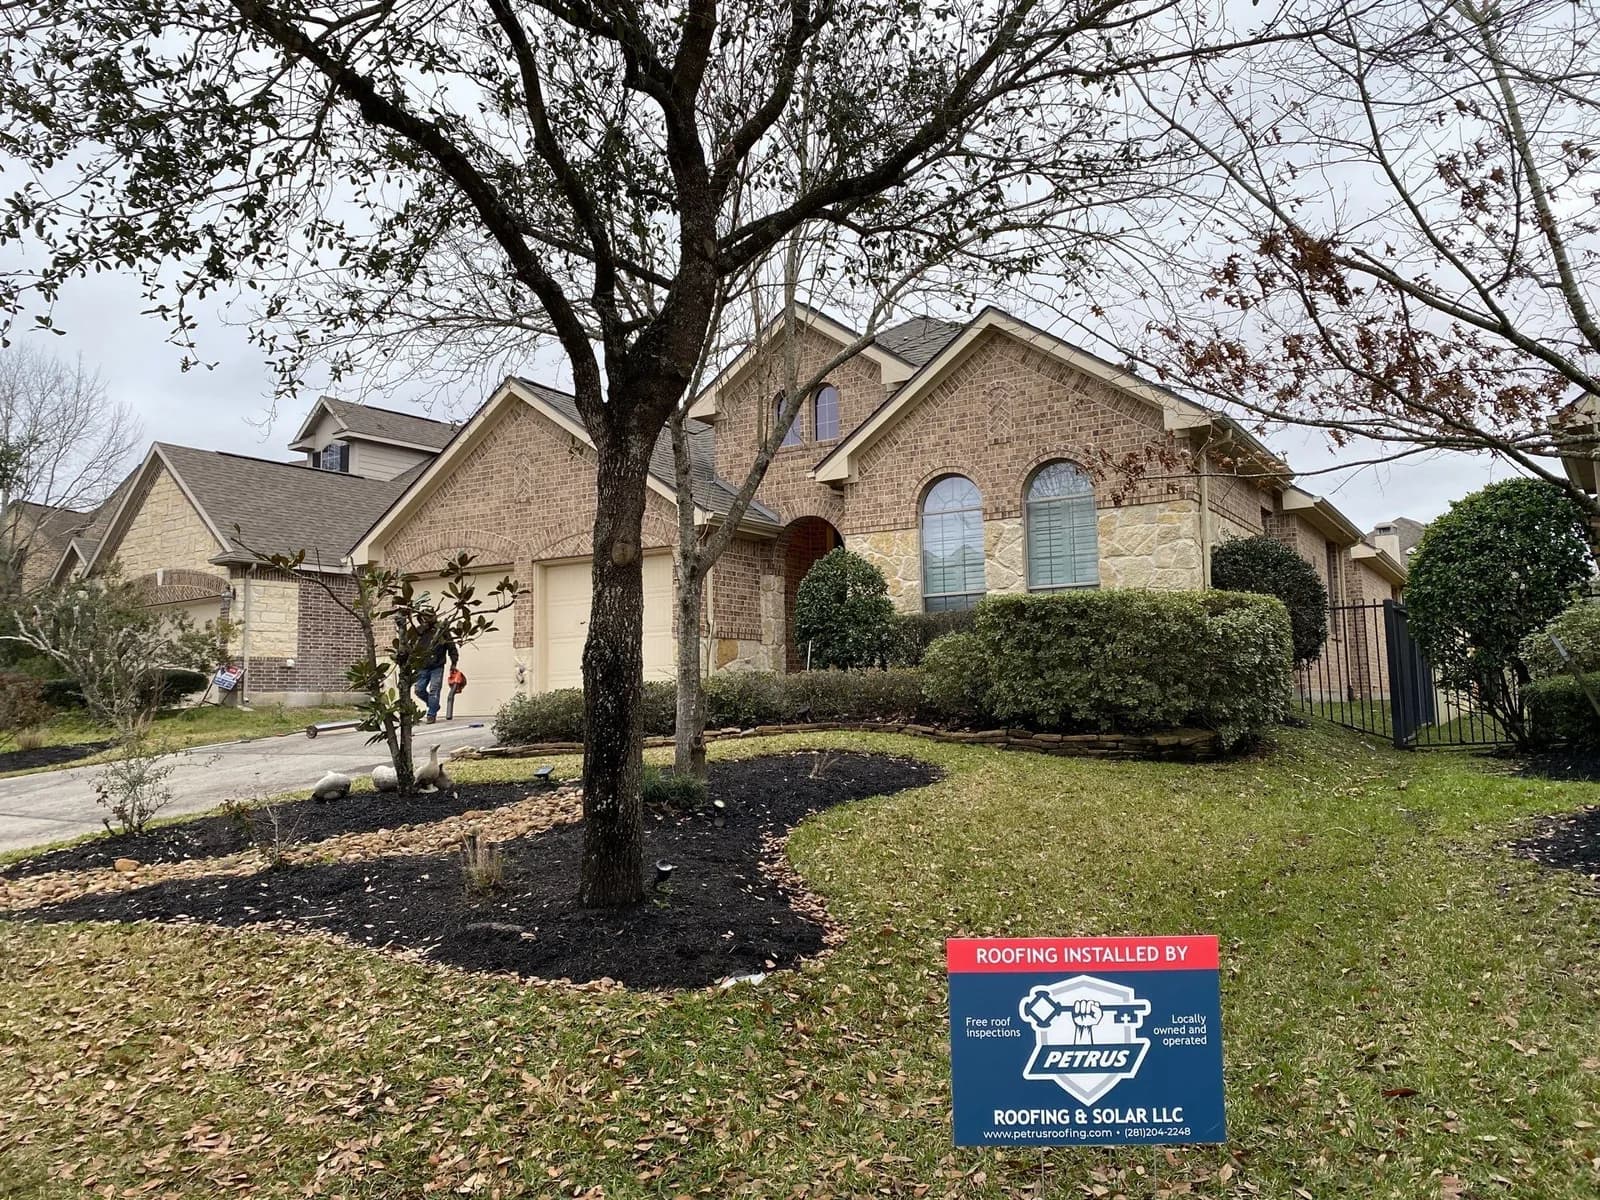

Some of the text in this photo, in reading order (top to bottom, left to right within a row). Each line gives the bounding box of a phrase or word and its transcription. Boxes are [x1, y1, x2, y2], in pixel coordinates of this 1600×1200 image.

[976, 945, 1189, 964] ROOFING INSTALLED BY
[966, 1016, 1012, 1027] Free roof
[1171, 1013, 1207, 1025] Locally
[966, 1027, 1021, 1039] inspections
[1153, 1024, 1207, 1035] owned and
[1162, 1035, 1207, 1047] operated
[1043, 1049, 1130, 1069] PETRUS
[994, 1106, 1184, 1125] ROOFING & SOLAR LLC
[983, 1127, 1191, 1139] www.petrusroofing.com (281)204-2248
